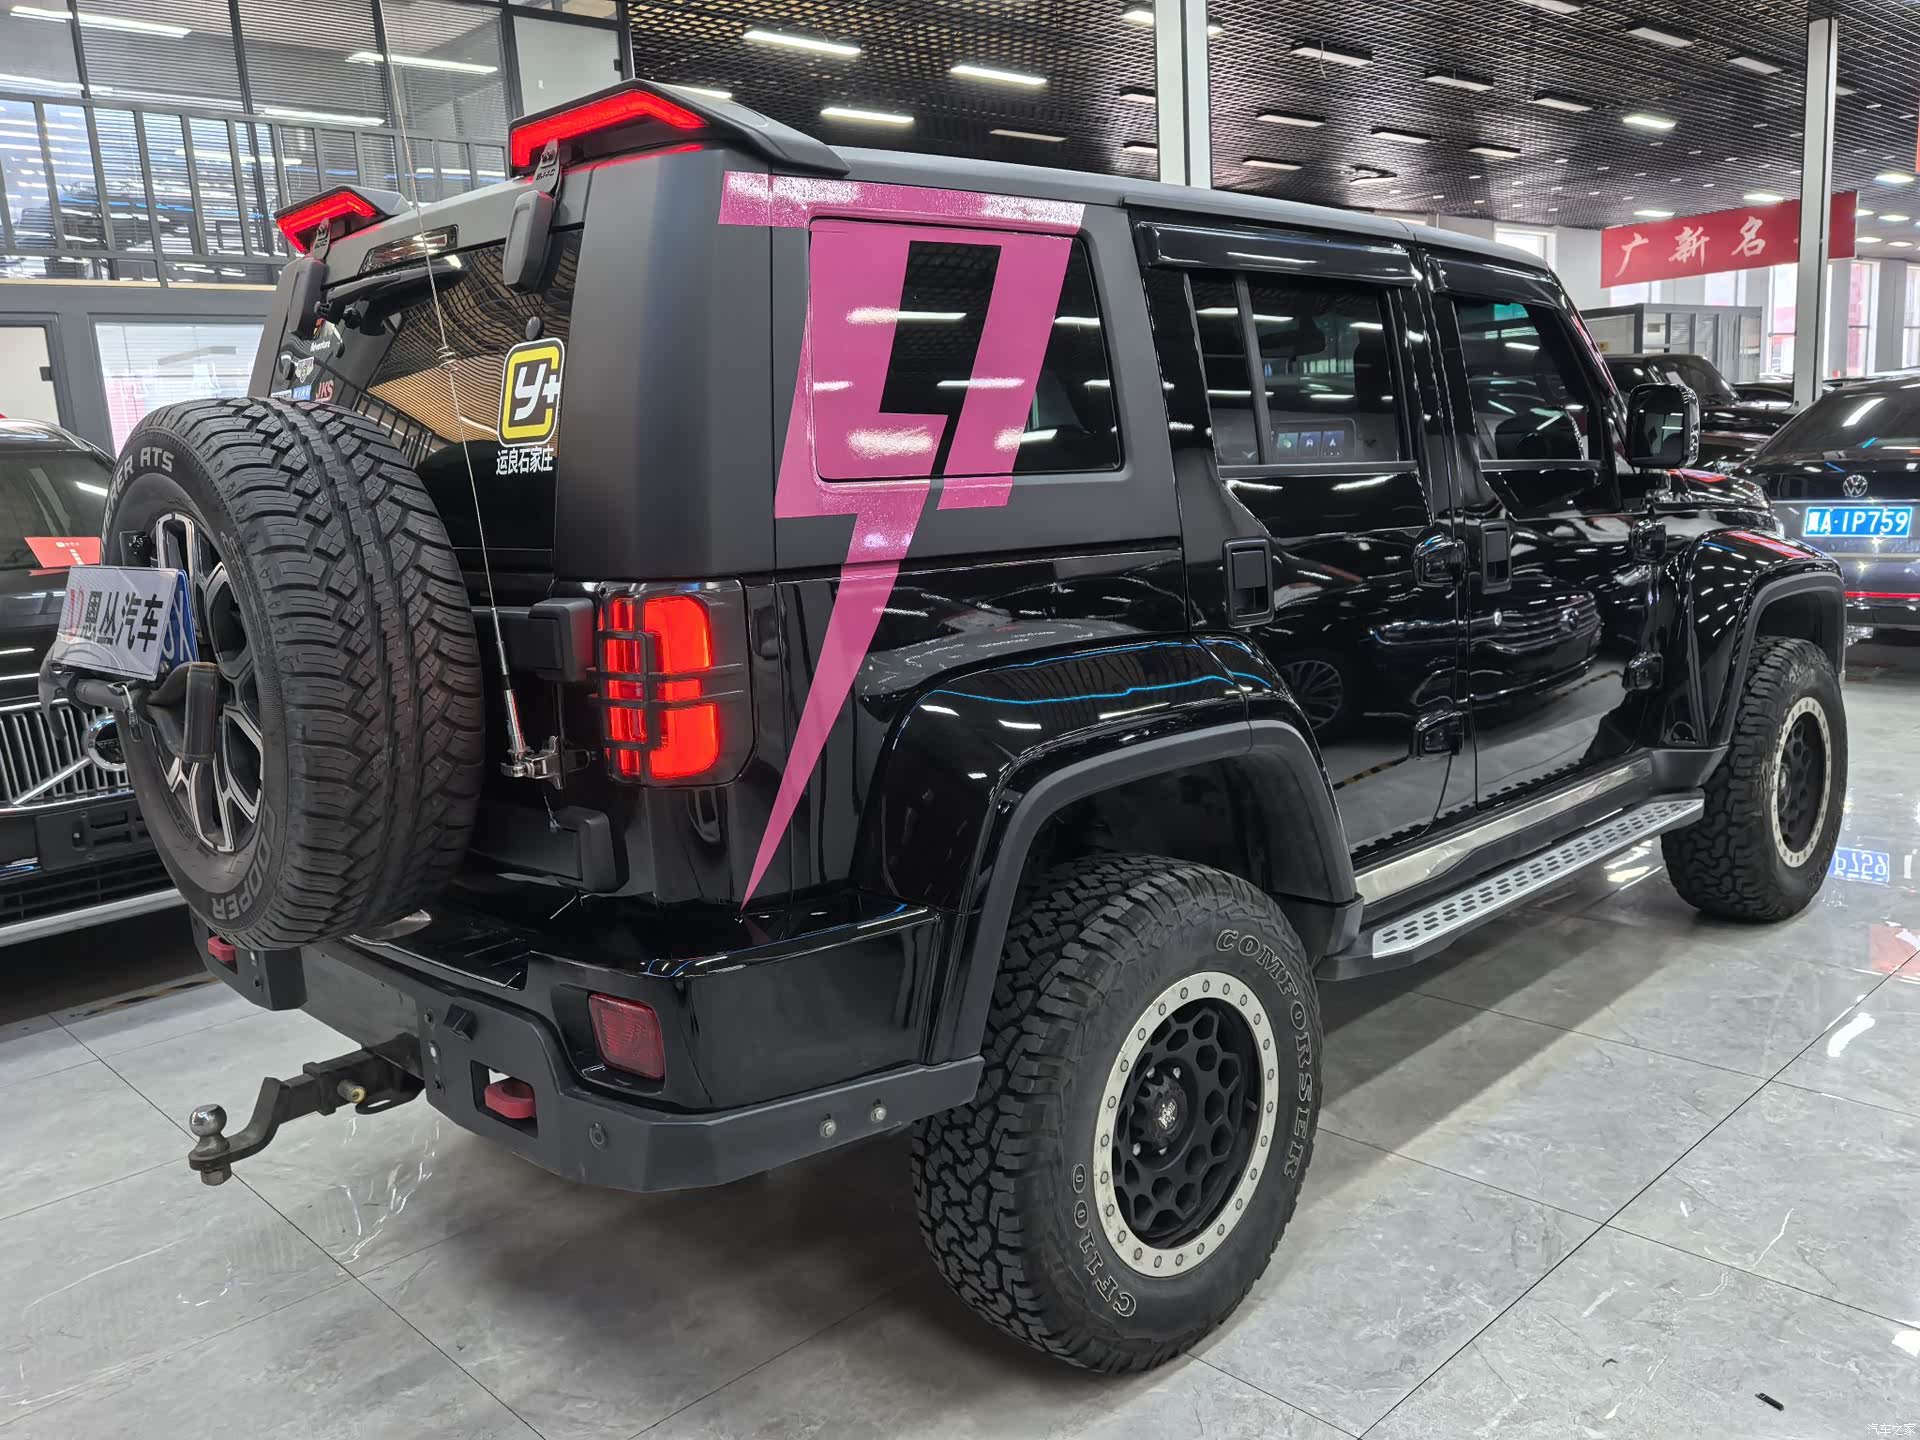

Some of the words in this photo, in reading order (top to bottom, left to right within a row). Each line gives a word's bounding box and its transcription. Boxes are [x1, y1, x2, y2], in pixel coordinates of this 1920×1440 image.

[1614, 216, 1799, 278] 广新名
[140, 446, 175, 473] ATS
[495, 446, 555, 476] 运良石家庄
[1216, 928, 1313, 1181] COMFORSER
[1072, 1162, 1137, 1318] CF1100
